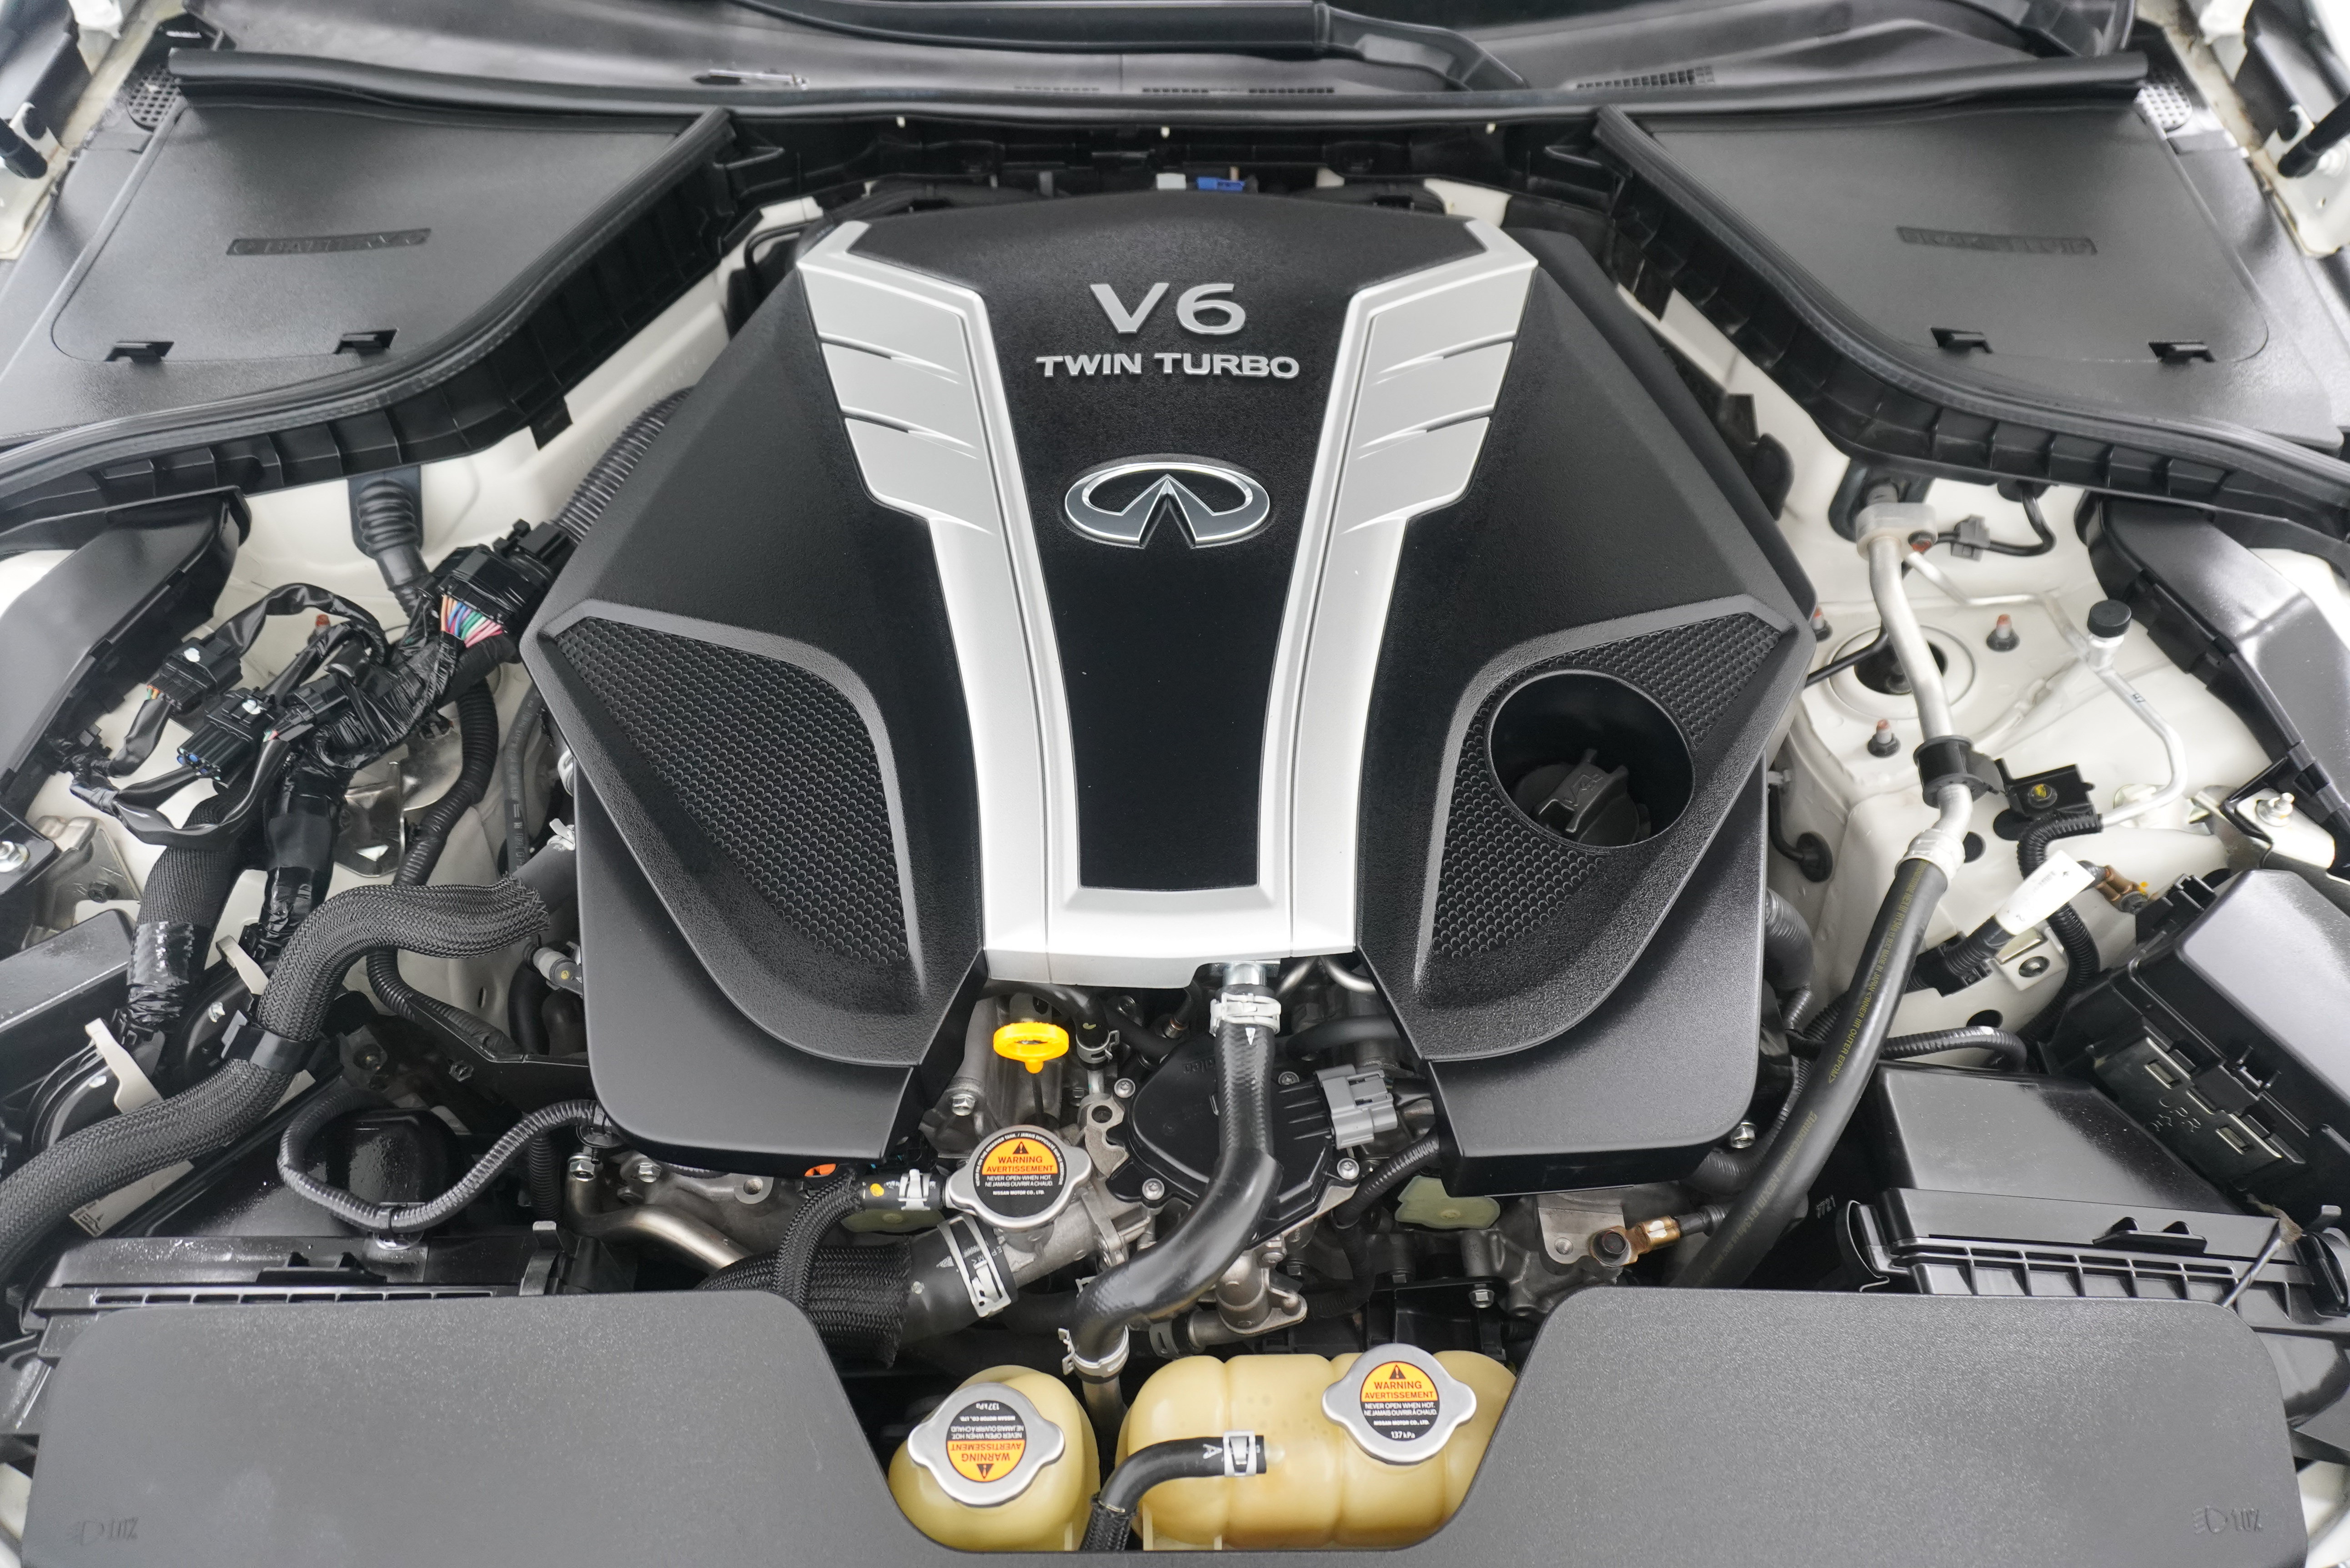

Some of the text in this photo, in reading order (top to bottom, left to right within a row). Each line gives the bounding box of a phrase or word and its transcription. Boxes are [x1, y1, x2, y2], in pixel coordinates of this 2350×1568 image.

[1090, 282, 1246, 335] V6
[1036, 352, 1300, 379] TWIN TURBO
[1878, 949, 1890, 965] MADE
[1868, 972, 1880, 992] JAPAN
[1841, 1029, 1857, 1055] OUTER
[1374, 1381, 1422, 1390] WARNING
[1402, 1431, 1416, 1439] kPa
[950, 1443, 1021, 1451] AVERTISSEMENT
[1203, 1443, 1223, 1459] A
[961, 1453, 1010, 1462] WARNING
